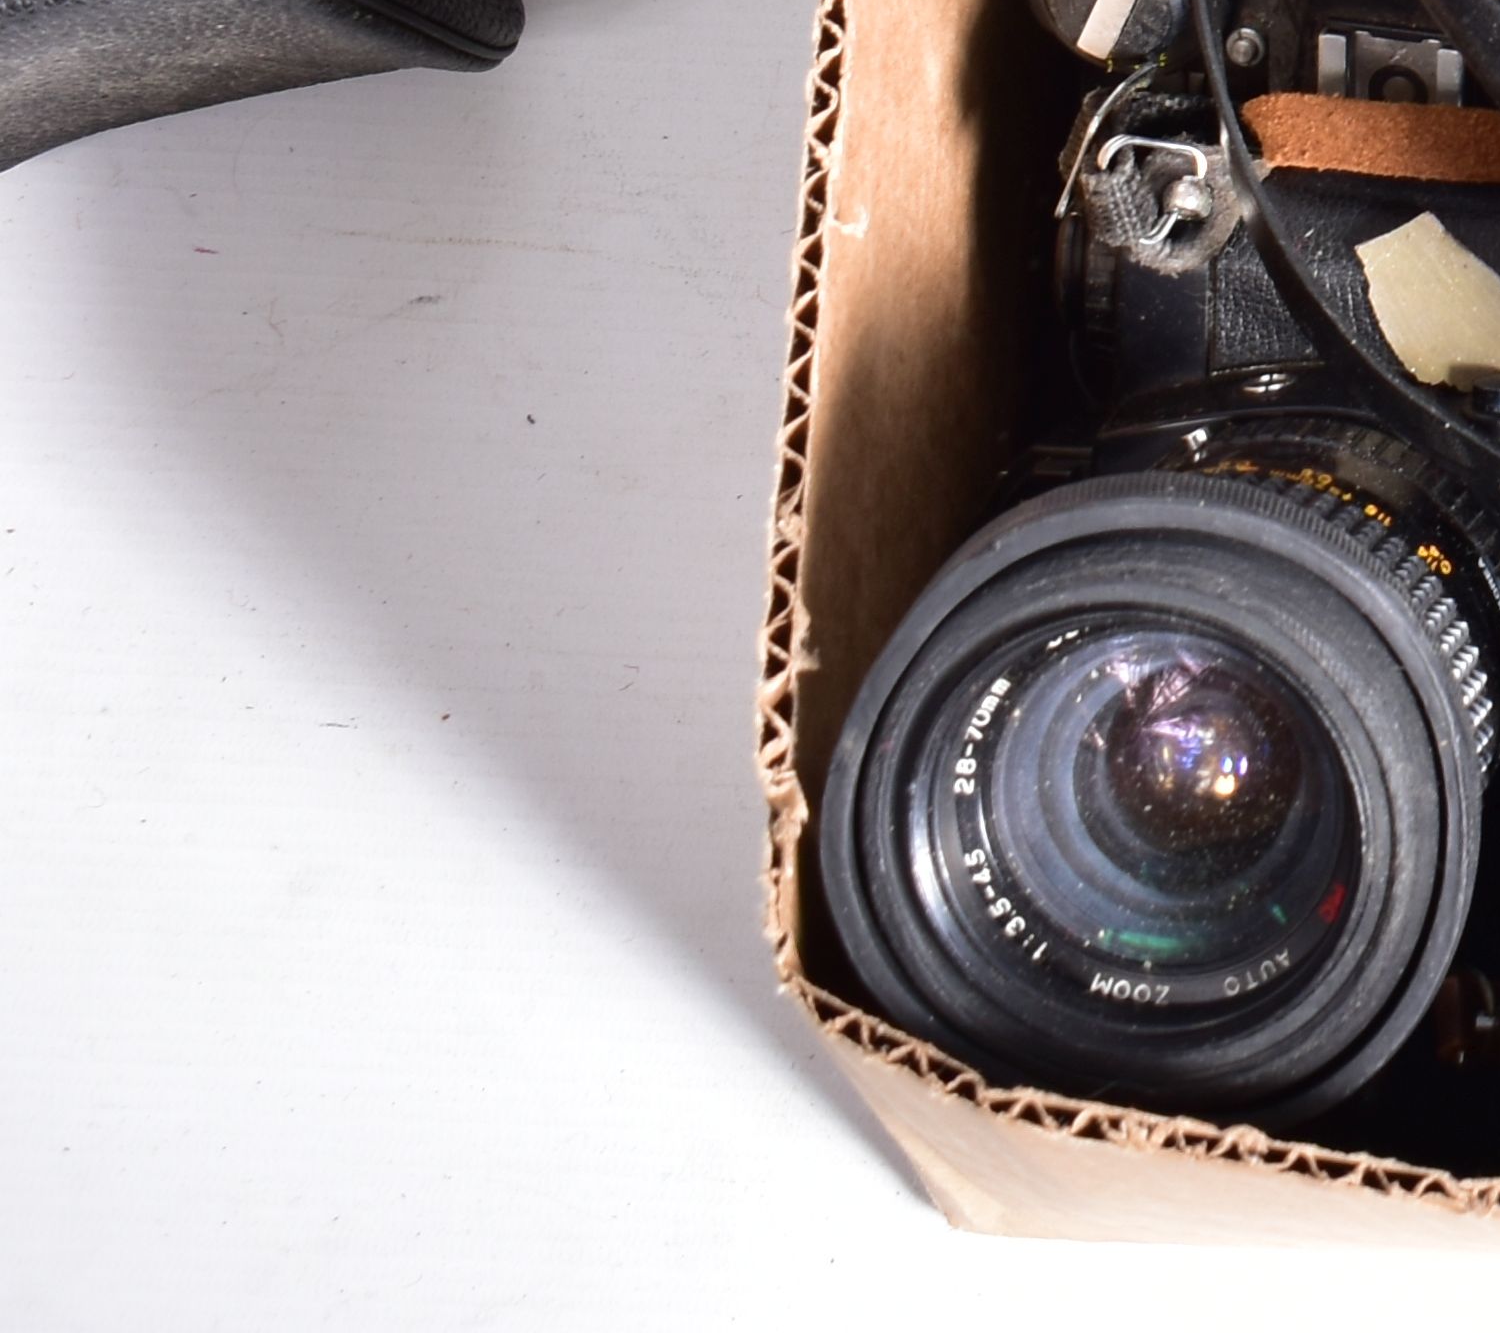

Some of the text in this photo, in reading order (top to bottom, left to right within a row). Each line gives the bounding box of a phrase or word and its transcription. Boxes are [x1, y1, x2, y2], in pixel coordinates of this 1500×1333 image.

[952, 675, 1013, 796] 28-70mm
[1089, 971, 1172, 1005] ZOOM
[1223, 947, 1292, 997] AUTO
